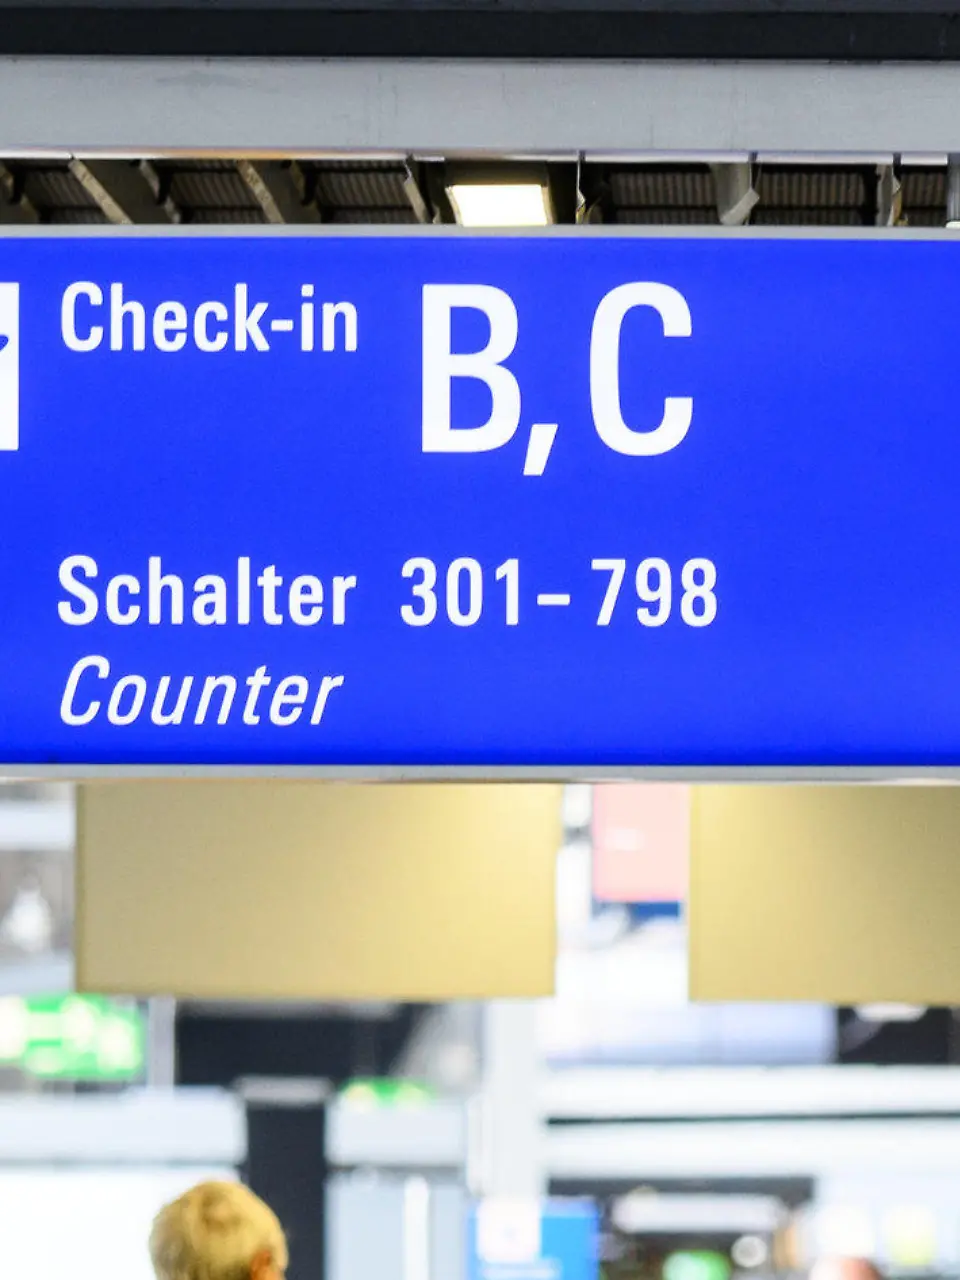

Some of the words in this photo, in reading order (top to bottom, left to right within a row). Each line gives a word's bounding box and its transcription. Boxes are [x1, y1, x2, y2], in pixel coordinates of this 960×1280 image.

[61, 281, 358, 353] Check-in
[57, 554, 357, 626] Schalter
[60, 654, 345, 726] Counter
